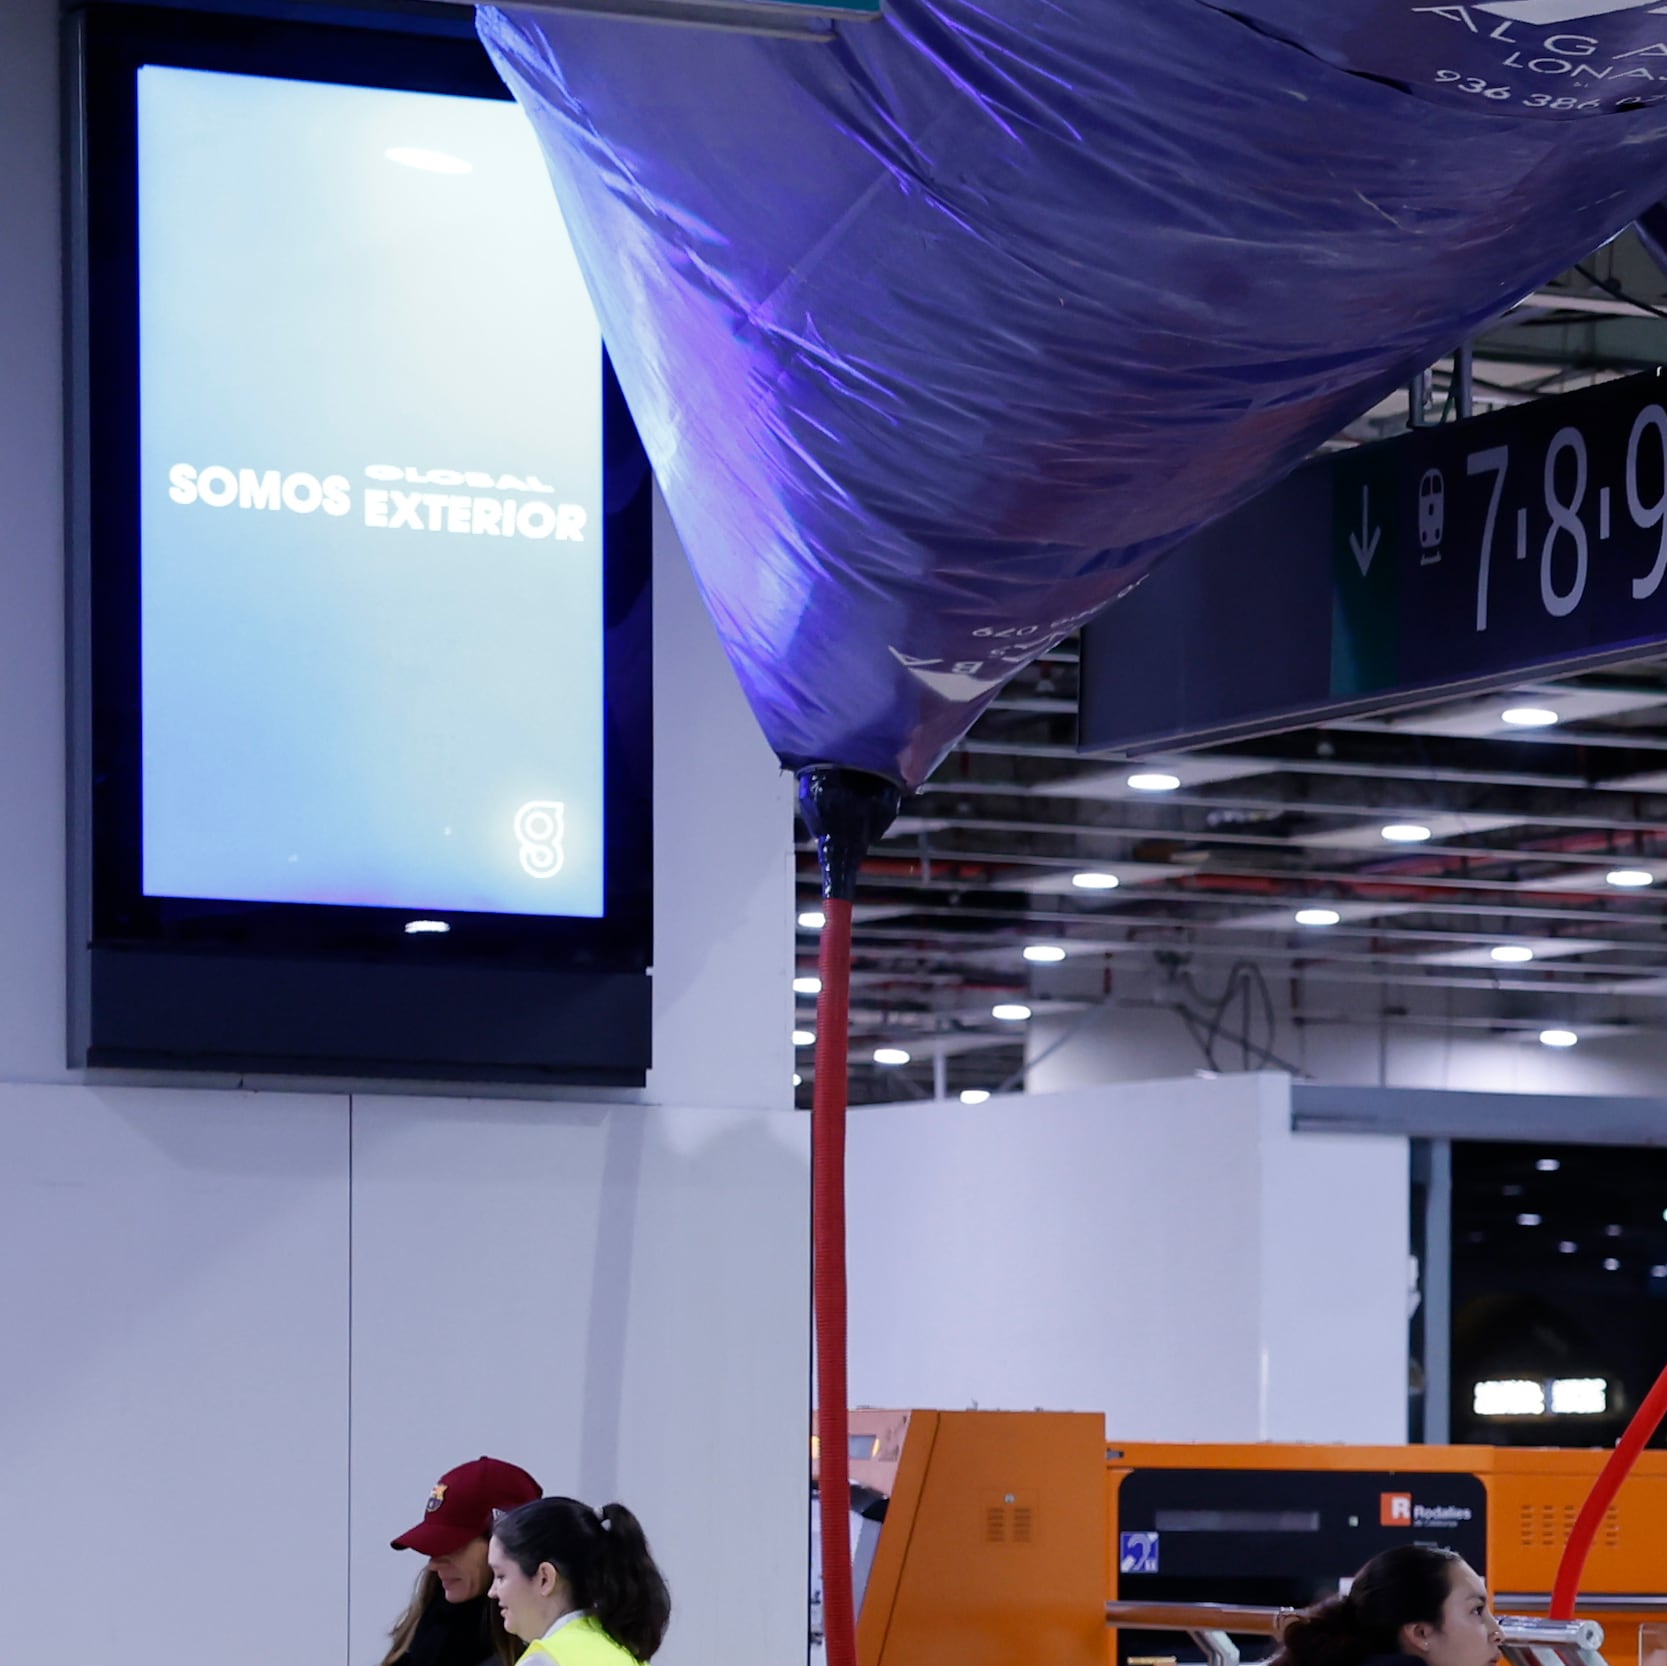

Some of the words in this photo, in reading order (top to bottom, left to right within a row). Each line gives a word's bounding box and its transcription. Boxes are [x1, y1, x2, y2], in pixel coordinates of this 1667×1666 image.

[1434, 69, 1511, 99] 936
[168, 463, 351, 517] SOMOS
[364, 488, 588, 542] EXTERIOR
[1391, 1497, 1412, 1520] R
[1414, 1504, 1473, 1520] Rodalies
